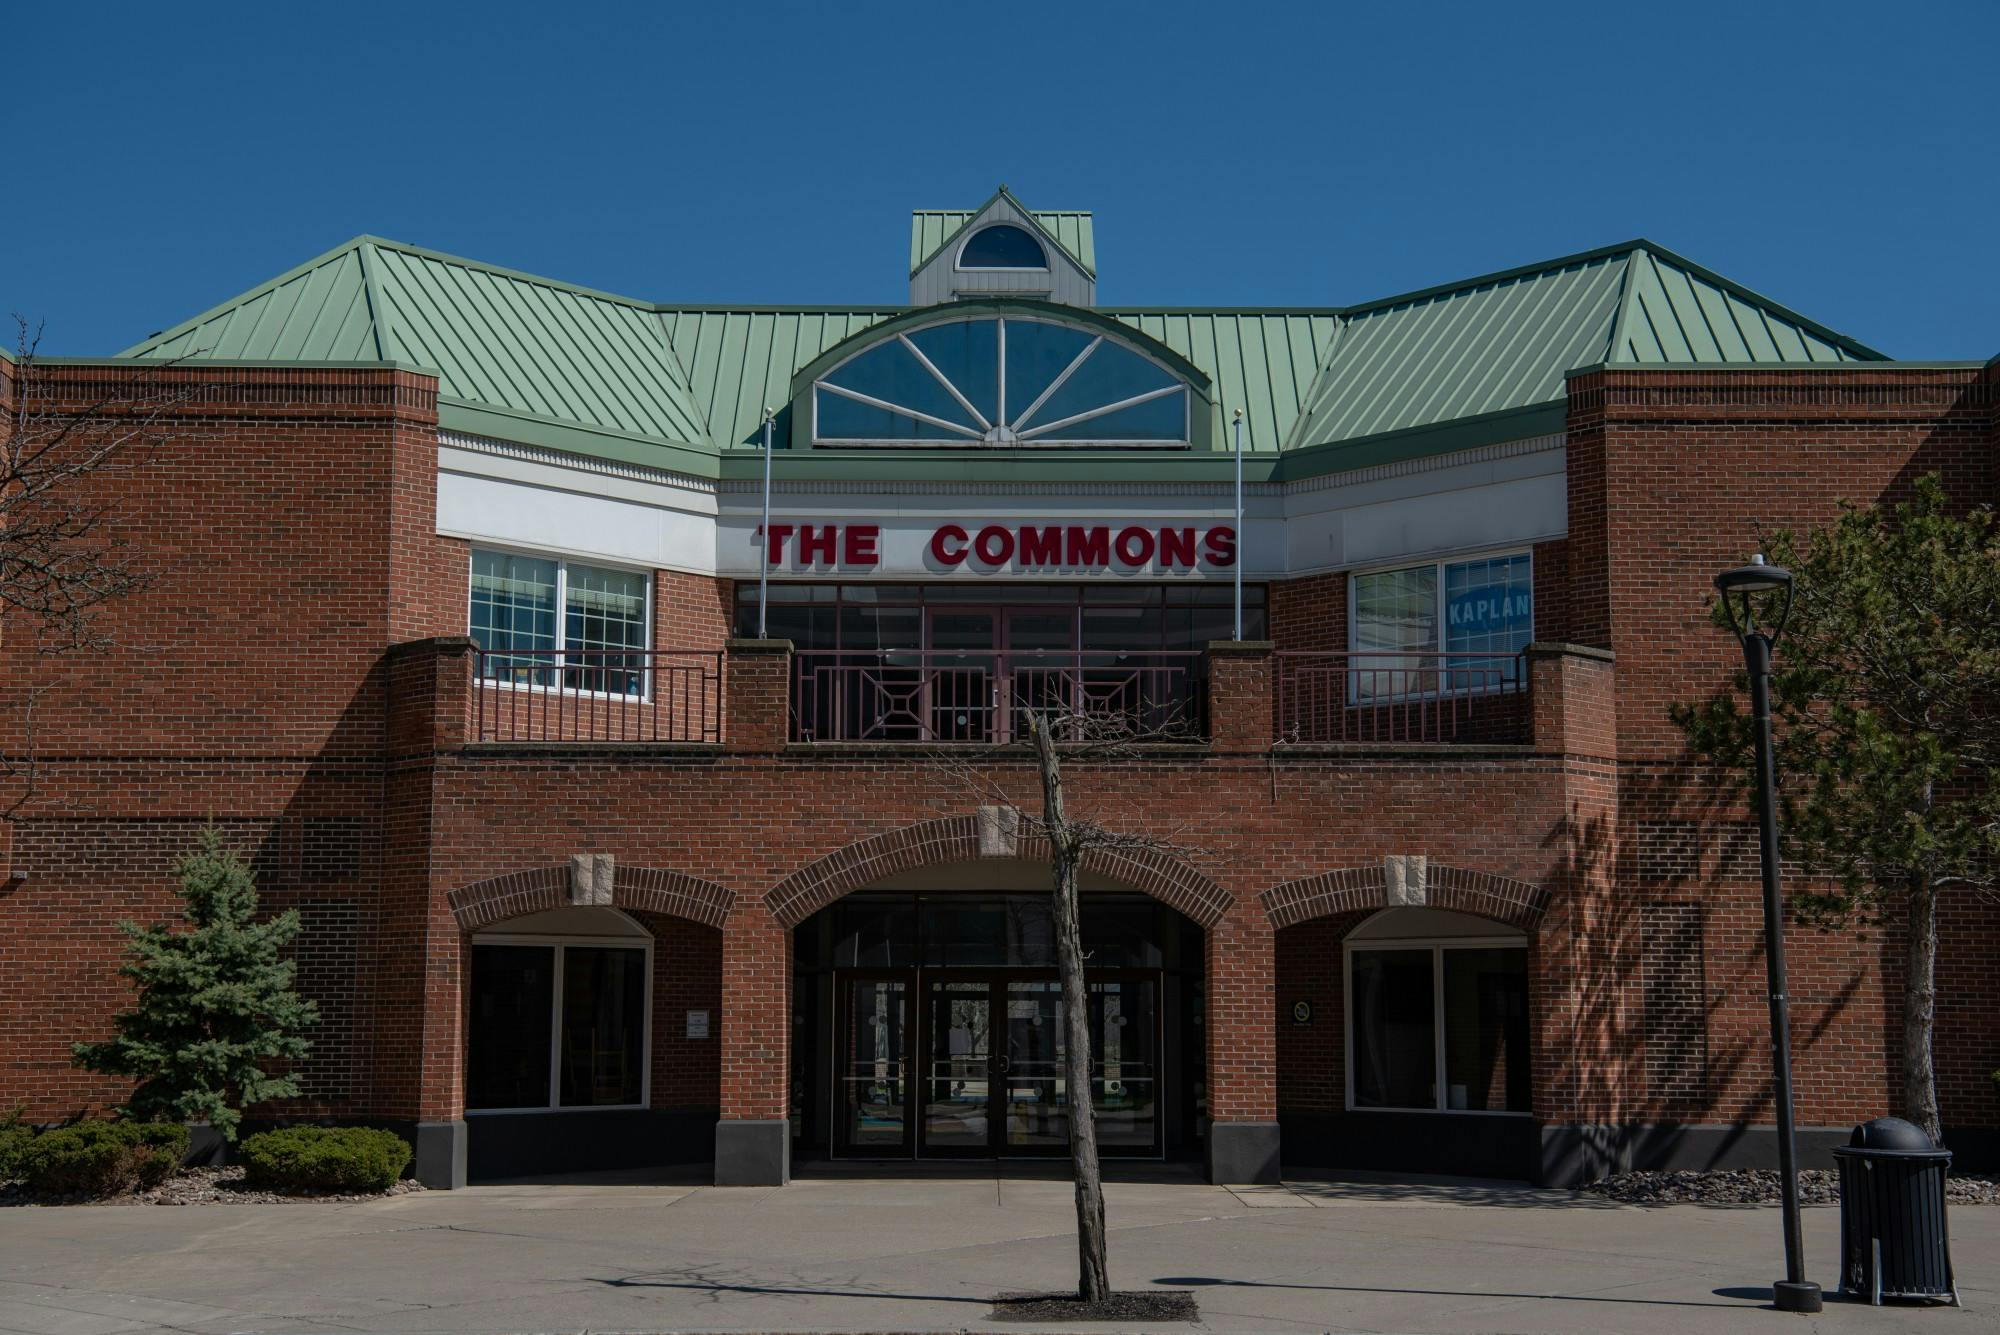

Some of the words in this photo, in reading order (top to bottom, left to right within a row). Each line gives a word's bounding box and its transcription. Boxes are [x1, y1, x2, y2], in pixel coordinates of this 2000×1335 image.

[759, 525, 879, 564] THE
[931, 525, 1236, 566] COMMONS
[1449, 595, 1528, 624] KAPLAN
